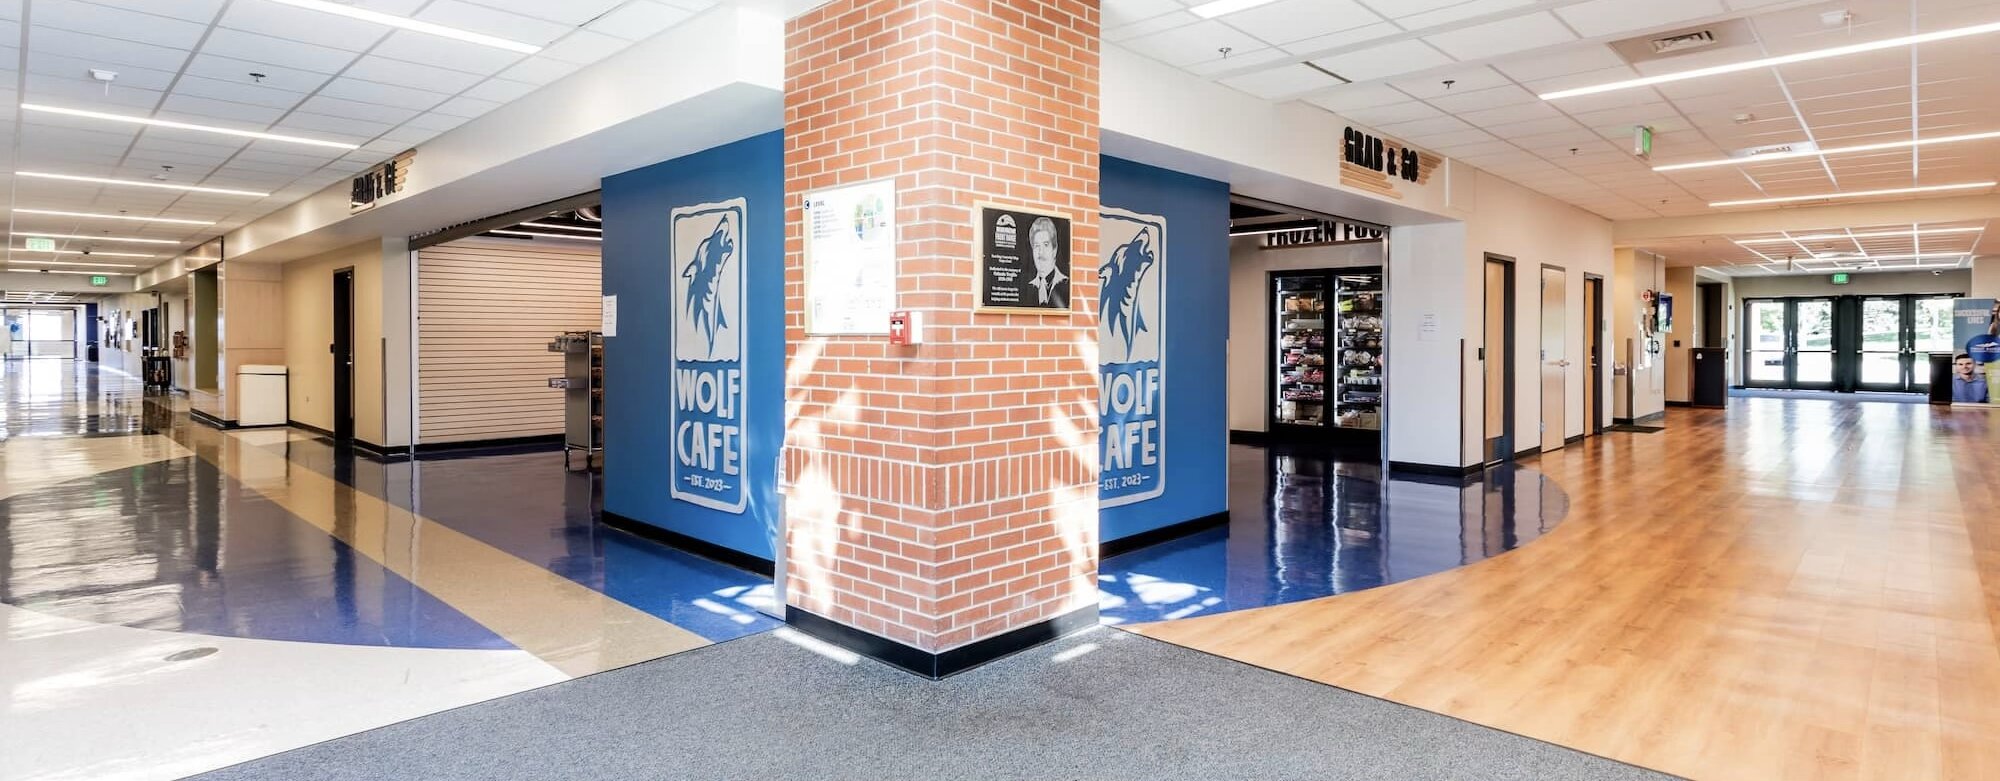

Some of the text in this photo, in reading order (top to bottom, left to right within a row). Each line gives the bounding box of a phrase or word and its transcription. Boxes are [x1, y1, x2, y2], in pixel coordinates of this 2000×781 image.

[1344, 126, 1418, 182] GRAB & GO
[1267, 221, 1337, 246] FROZEN
[676, 369, 740, 420] WOLF
[677, 420, 740, 476] CAFE
[1099, 419, 1157, 472] AFE
[705, 478, 724, 492] 2023
[1104, 472, 1142, 490] EST. 2023
